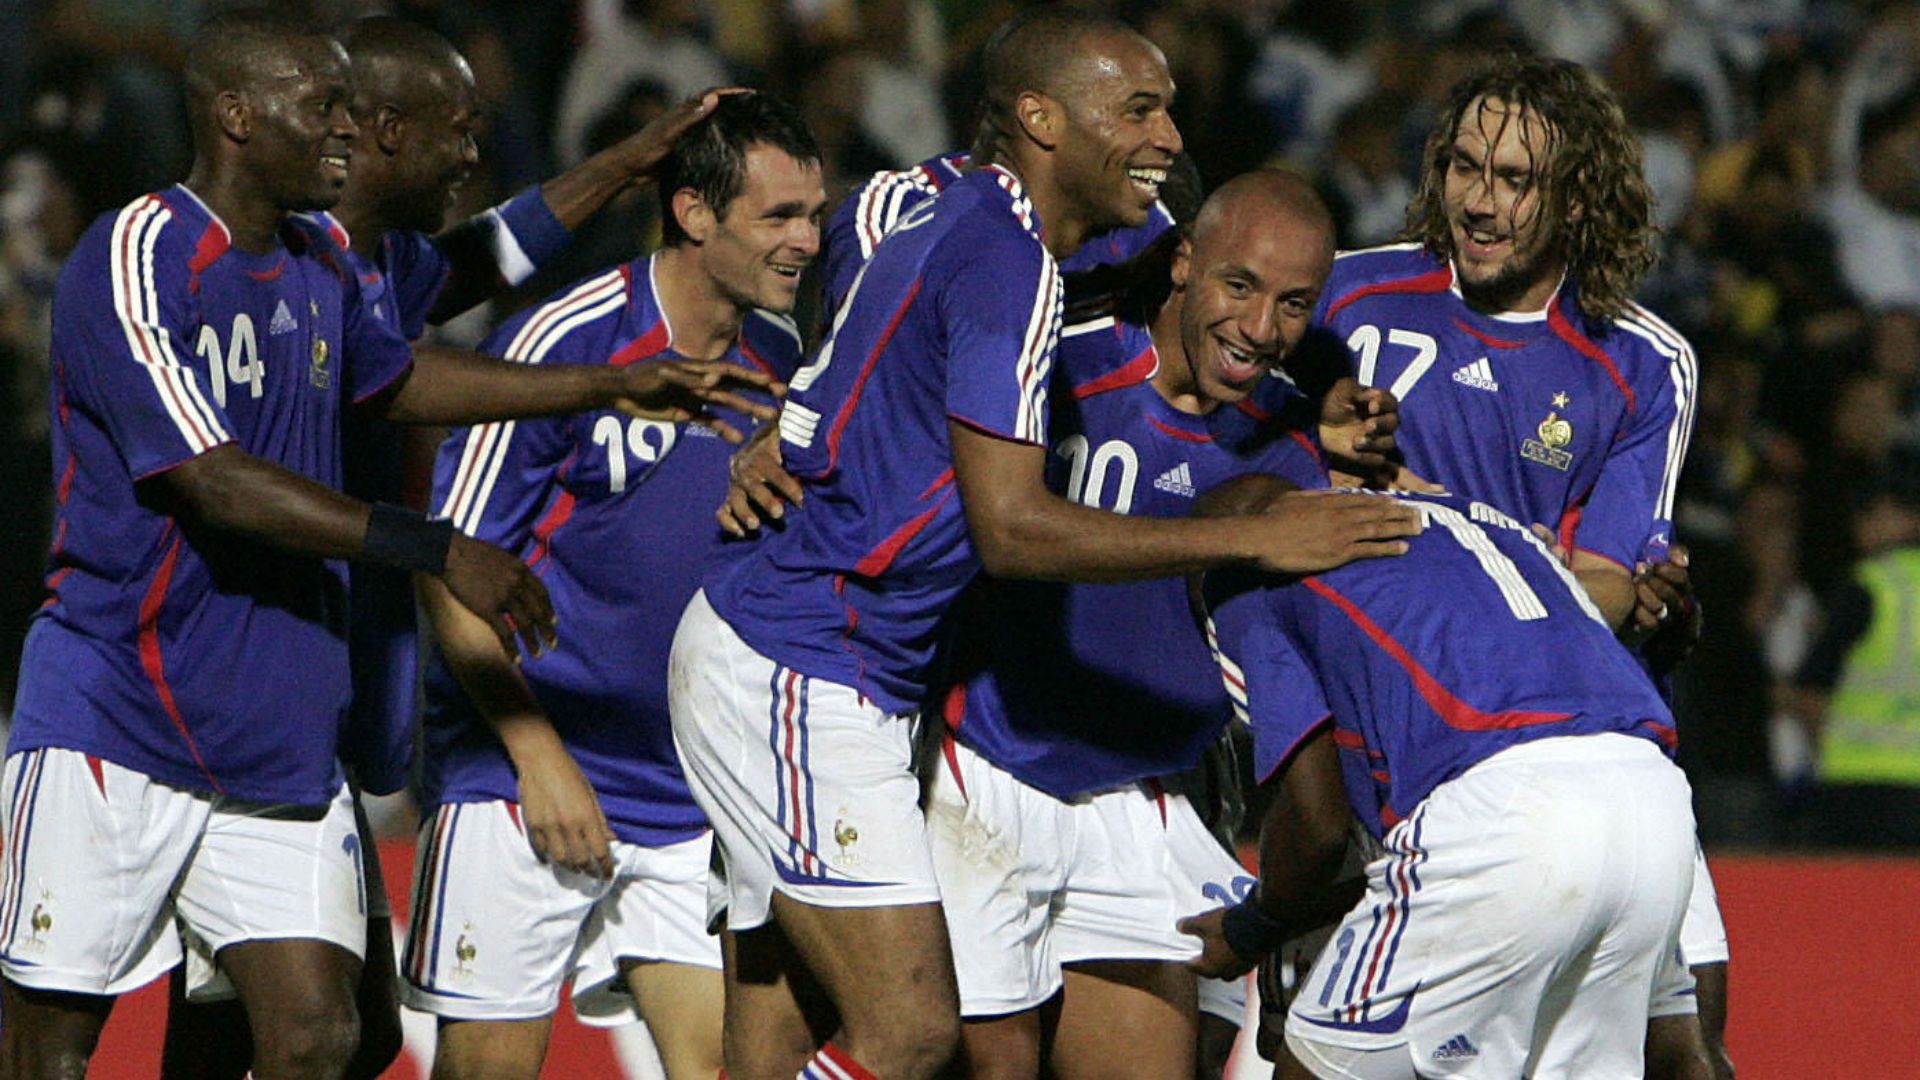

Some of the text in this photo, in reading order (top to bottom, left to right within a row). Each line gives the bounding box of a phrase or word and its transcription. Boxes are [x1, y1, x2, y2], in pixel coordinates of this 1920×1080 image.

[196, 312, 265, 409] 14
[1347, 324, 1437, 402] 17
[1452, 371, 1499, 392] adidas
[592, 415, 677, 493] 19
[1056, 434, 1139, 515] 10
[1153, 478, 1196, 498] adidas
